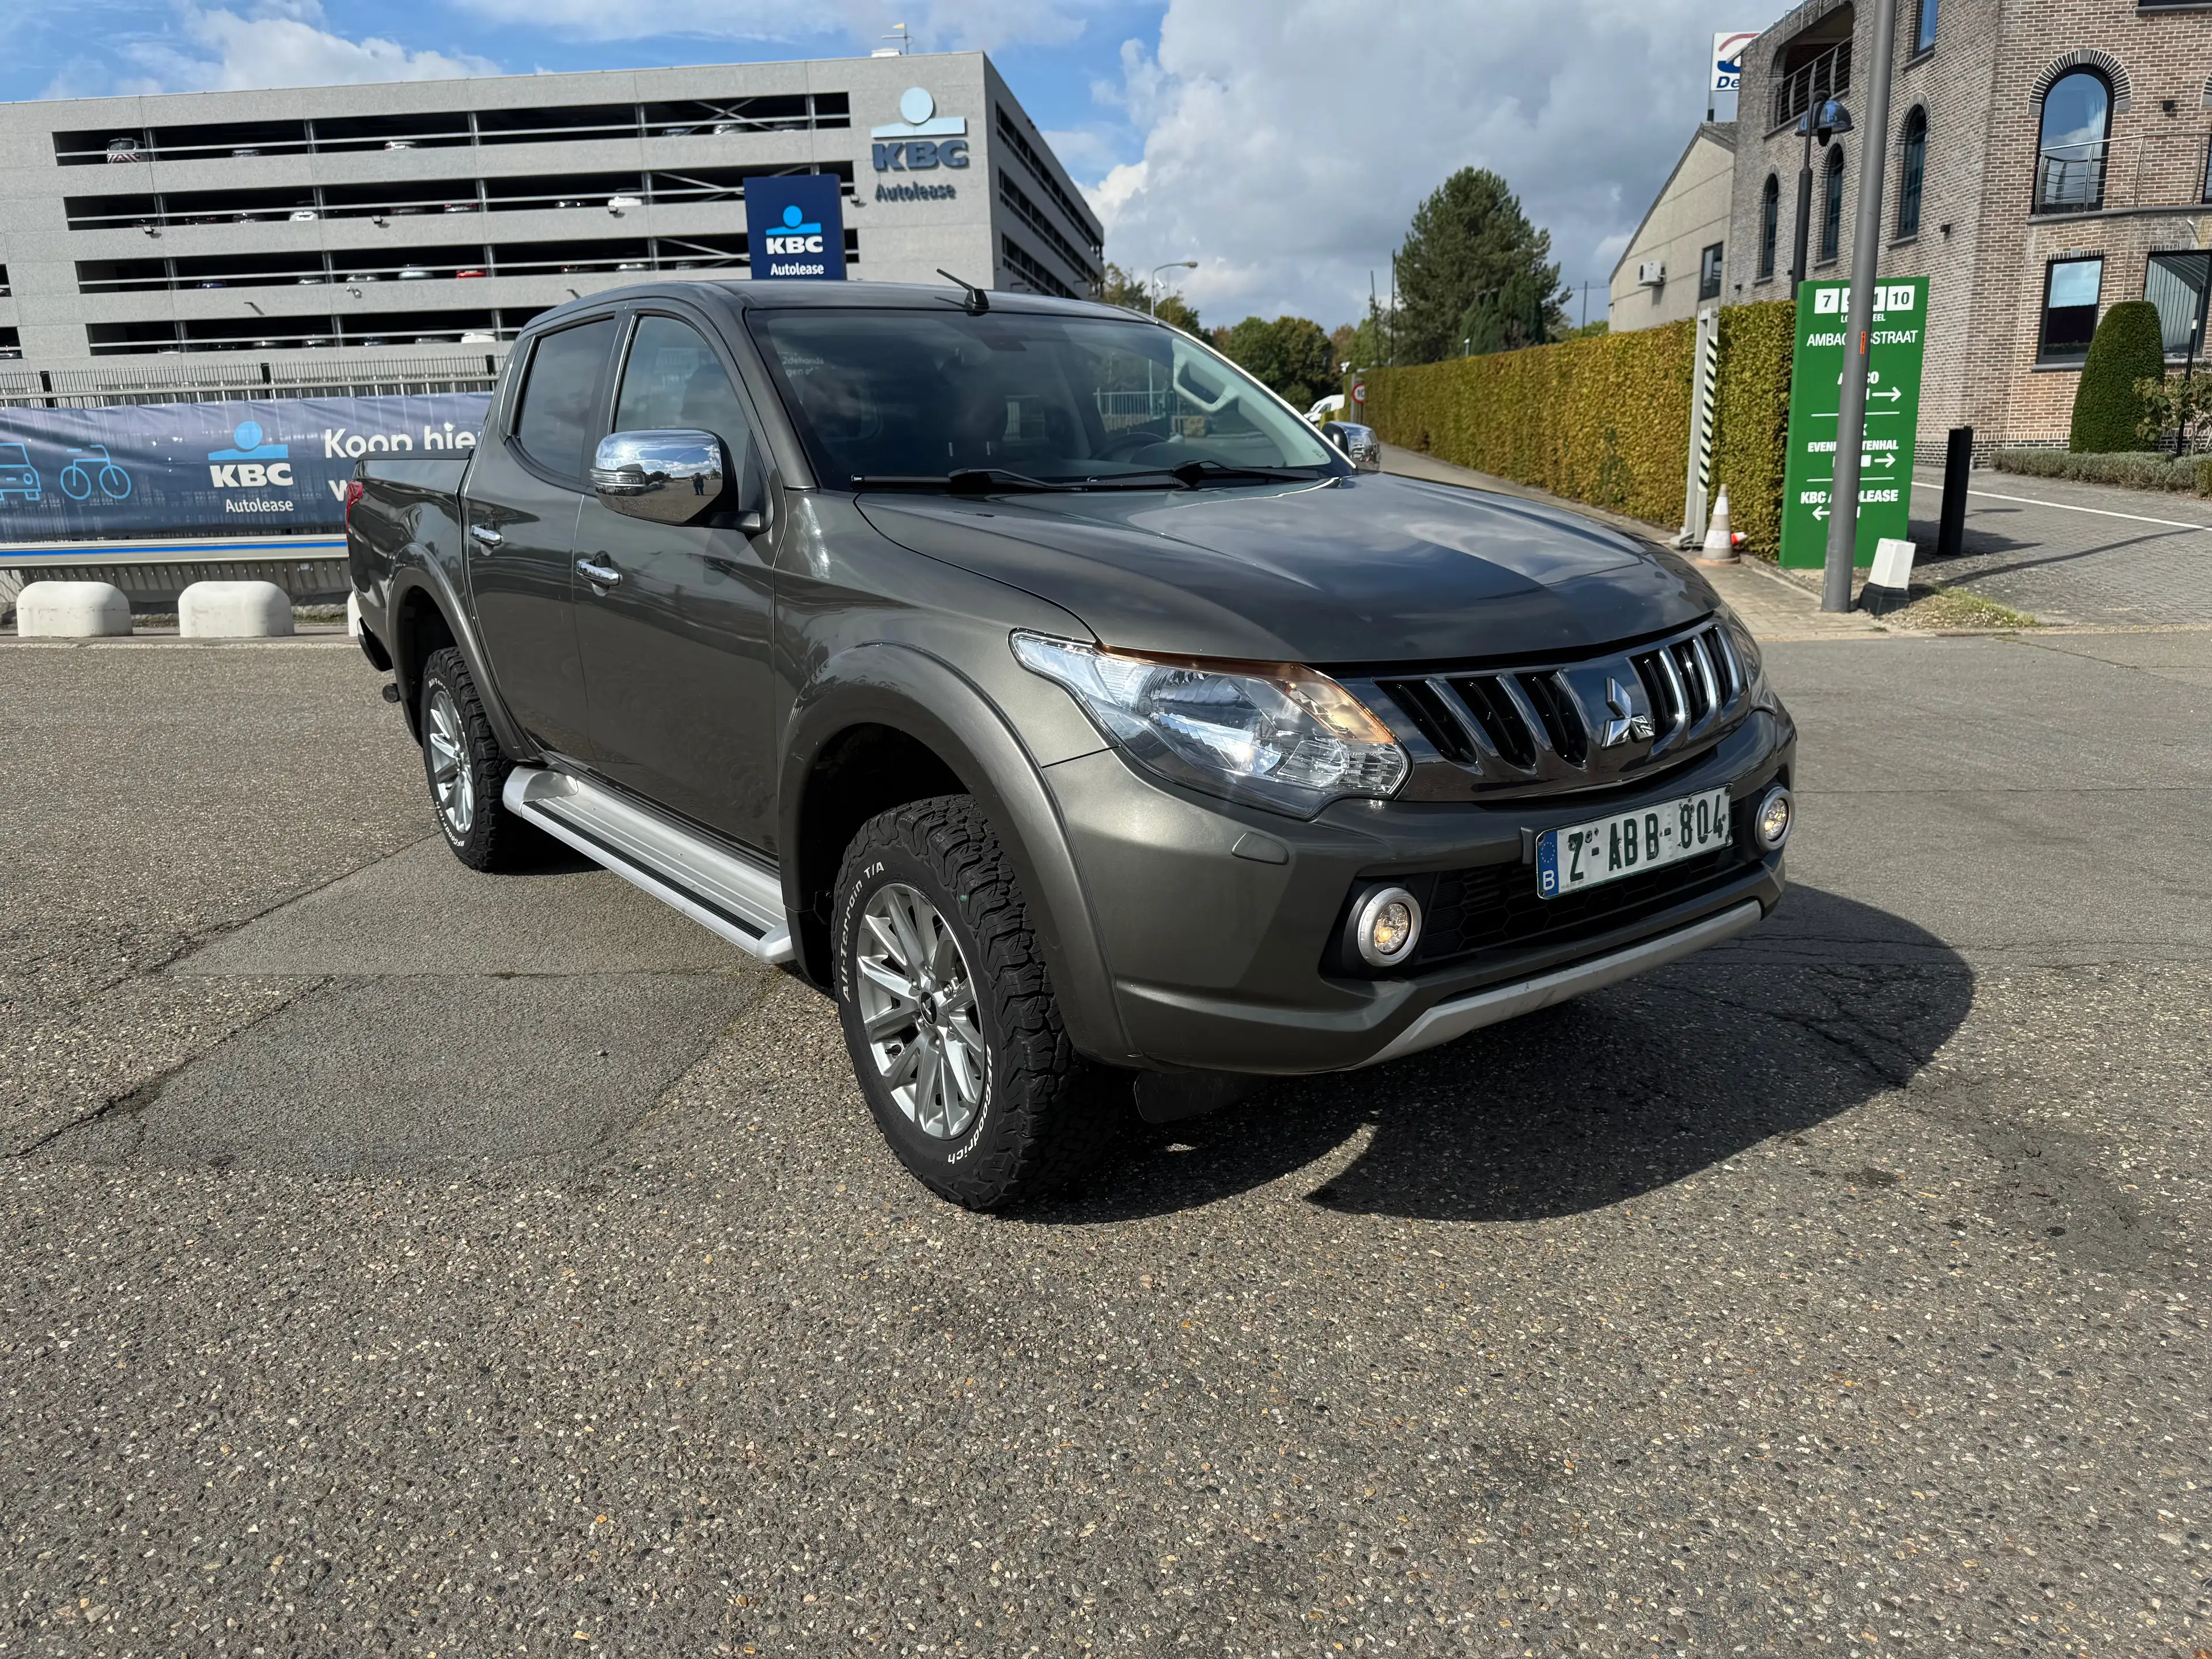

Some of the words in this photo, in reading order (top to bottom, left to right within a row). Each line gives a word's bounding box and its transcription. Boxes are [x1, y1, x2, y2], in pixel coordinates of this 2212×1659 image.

[872, 140, 969, 172] KBC
[875, 181, 956, 202] Autolease
[766, 236, 824, 255] KBC
[770, 262, 824, 276] Autolease
[1823, 295, 1831, 308] 7
[1892, 291, 1910, 305] 10
[424, 422, 481, 450] hie
[210, 463, 294, 488] KBC
[225, 498, 294, 513] Autolease
[1800, 491, 1826, 504] KBC
[1568, 794, 1724, 882] Z-ABB-804
[1543, 870, 1555, 891] B
[840, 880, 863, 1003] All-Terrain
[864, 862, 885, 879] T/A
[948, 1044, 993, 1165] BFGoodrich
